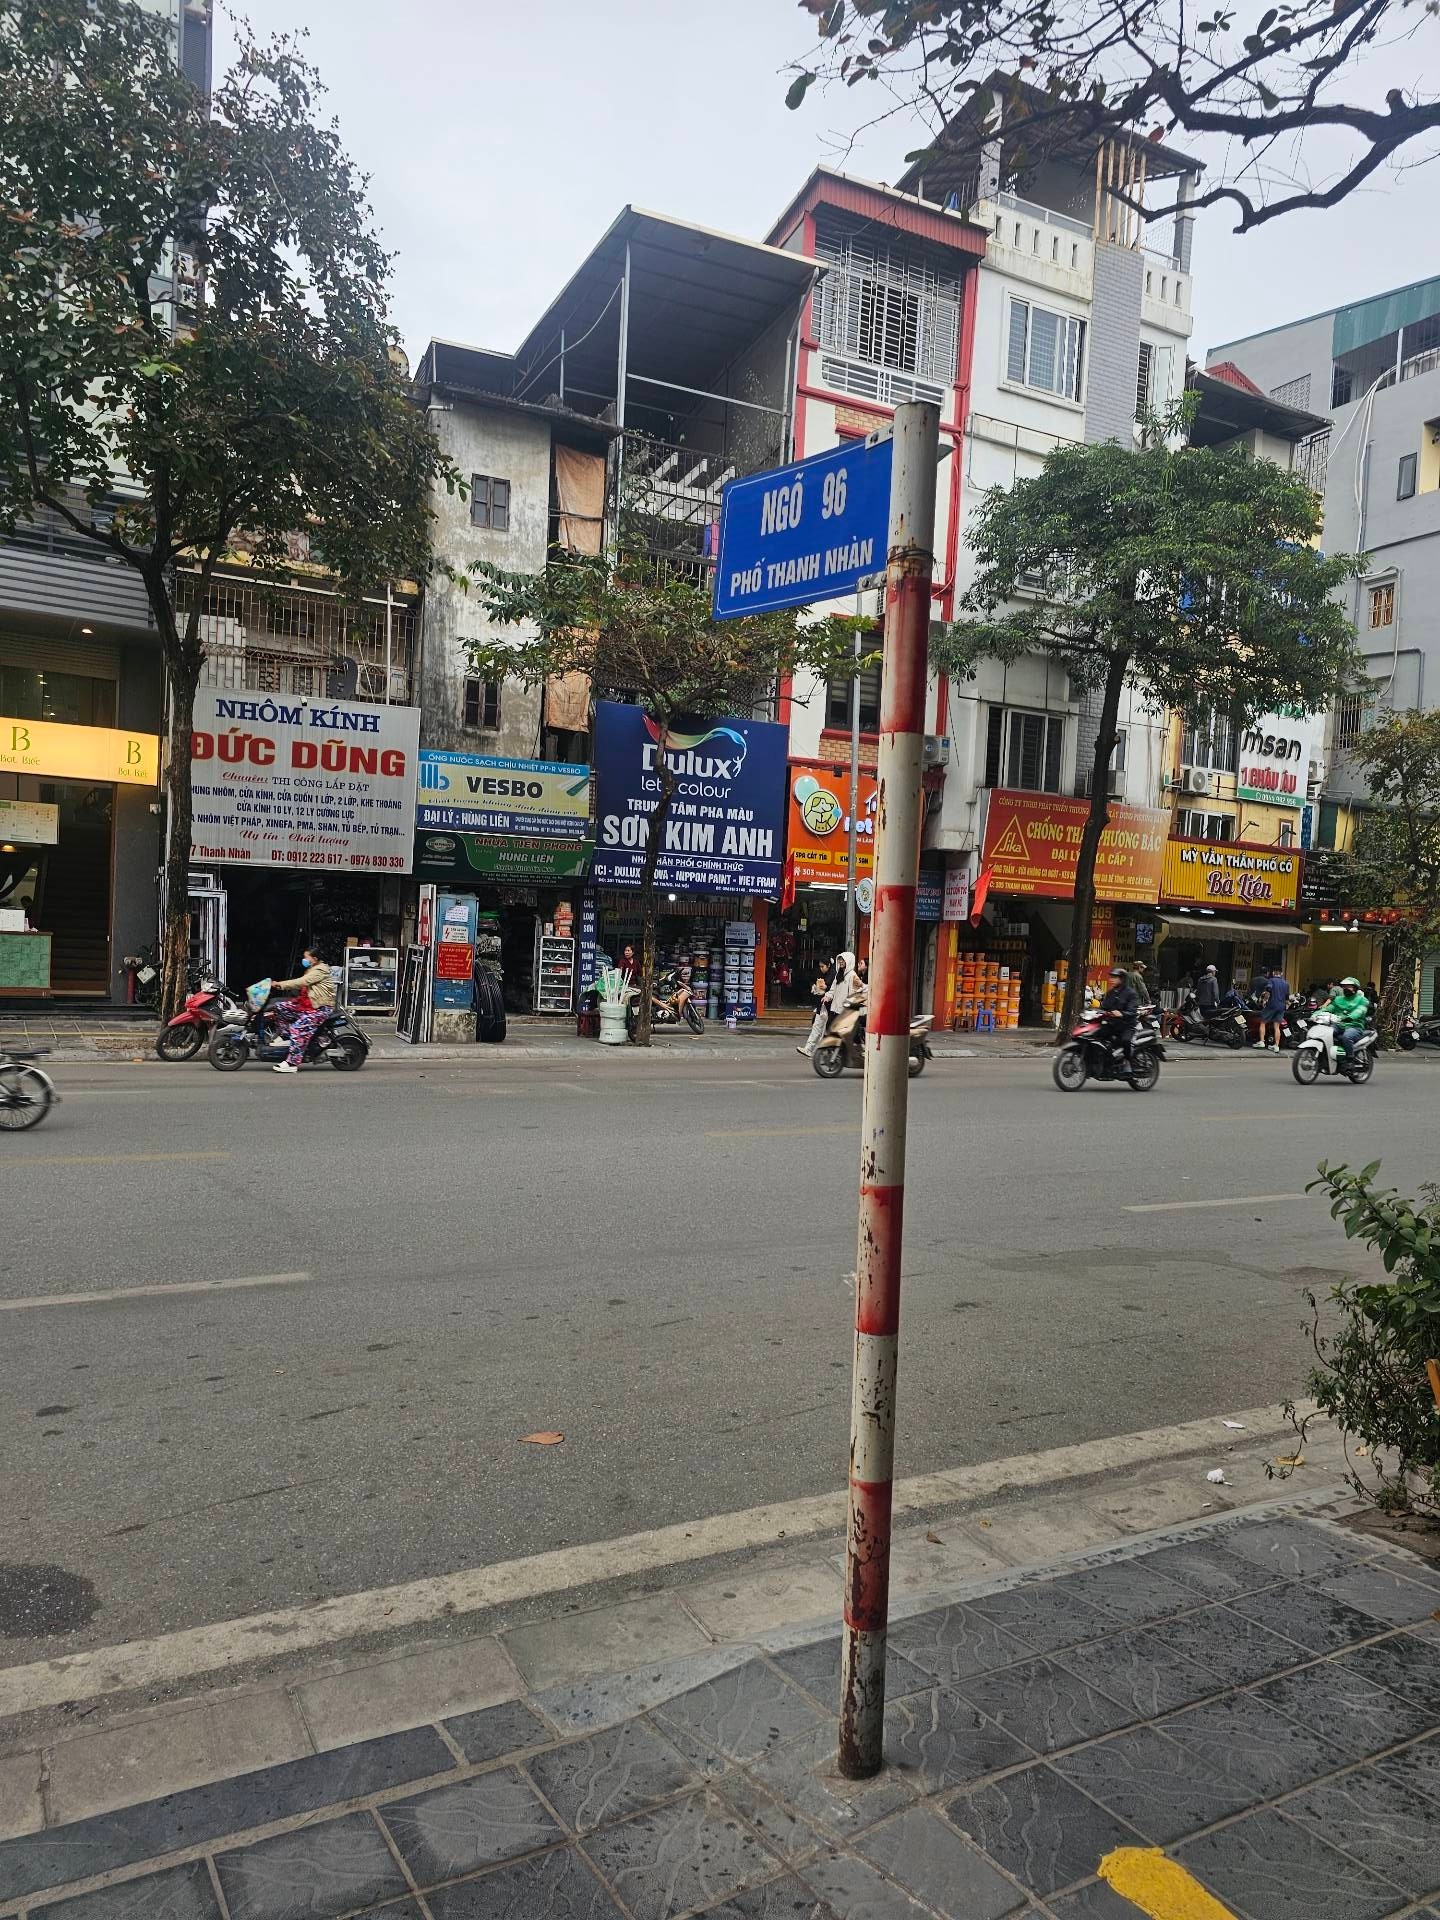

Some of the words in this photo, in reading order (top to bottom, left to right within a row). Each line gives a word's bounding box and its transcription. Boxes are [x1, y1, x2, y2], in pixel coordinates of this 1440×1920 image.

[761, 472, 803, 536] NGÕ
[822, 468, 848, 520] 96
[730, 557, 766, 597] PHỐ
[767, 553, 820, 590] THANH
[824, 535, 874, 576] NHÀN
[216, 698, 302, 725] NHÔM
[310, 705, 380, 733] KÍNH
[11, 726, 31, 751] B
[126, 740, 142, 765] B
[191, 727, 276, 766] ĐỨC
[292, 739, 406, 777] DŨNG
[642, 743, 732, 779] Dulux
[475, 759, 497, 767] SẠCH
[498, 761, 517, 769] CHỊU
[557, 767, 581, 775] VESBO
[191, 785, 211, 796] HUNG
[239, 785, 254, 799] CỬA
[277, 788, 292, 802] CỬA
[338, 797, 343, 805] 2
[360, 798, 374, 807] KHE
[271, 776, 291, 785] THI
[293, 777, 323, 788] CÔNG
[325, 778, 346, 790] LẮP
[348, 782, 370, 793] ĐẶT
[466, 776, 543, 799] VESBO
[641, 775, 662, 792] let
[677, 781, 732, 799] colour
[236, 799, 252, 813] CỬA
[253, 803, 271, 813] KÍNH
[273, 805, 282, 814] 10
[283, 806, 294, 816] LY,
[296, 807, 305, 816] 12
[306, 808, 315, 817] LY
[316, 807, 340, 819] CƯỜNG
[341, 810, 355, 821] LỰC
[423, 809, 441, 825] ĐẠI
[442, 809, 454, 823] LÝ
[461, 811, 488, 827] HÙNG
[489, 813, 510, 828] LIÊN
[627, 798, 660, 812] TRUN
[671, 801, 698, 817] TÂM
[700, 805, 724, 819] PHA
[726, 804, 754, 821] MÀU
[197, 812, 221, 825] NHÔM
[222, 814, 239, 826] VIỆT
[342, 820, 351, 833] TỦ
[370, 822, 379, 836] TỦ
[1026, 816, 1064, 842] CHỐNG
[1066, 825, 1084, 844] TH
[543, 841, 583, 852] PHONG
[602, 814, 651, 848] SƠN
[665, 820, 715, 853] KIM
[721, 825, 773, 858] ANH
[1000, 832, 1022, 854] Sika
[1140, 826, 1162, 852] BẮC
[199, 845, 226, 858] Thanh
[286, 851, 308, 863] 0912
[309, 852, 325, 862] 223
[327, 853, 343, 864] 617
[350, 855, 371, 866] 0974
[372, 856, 388, 867] 830
[389, 857, 404, 868] 330
[656, 856, 674, 867] HÂN
[675, 856, 695, 868] PHỐI
[696, 860, 722, 871] CHÍNH
[723, 861, 744, 872] THỨC
[1051, 848, 1068, 862] ĐẠI
[1107, 850, 1127, 866] CẤP
[1129, 855, 1134, 867] 1
[1256, 856, 1279, 873] PHỐ
[594, 864, 607, 876] ICI
[614, 865, 640, 878] DULUX
[653, 868, 669, 880] OVA
[675, 870, 707, 883] NIPPON
[708, 873, 731, 885] PAINT
[756, 876, 777, 888] FRAN
[802, 868, 815, 876] 303
[1207, 870, 1235, 896] Bà
[1238, 872, 1273, 904] Liên
[1091, 906, 1112, 919] 305
